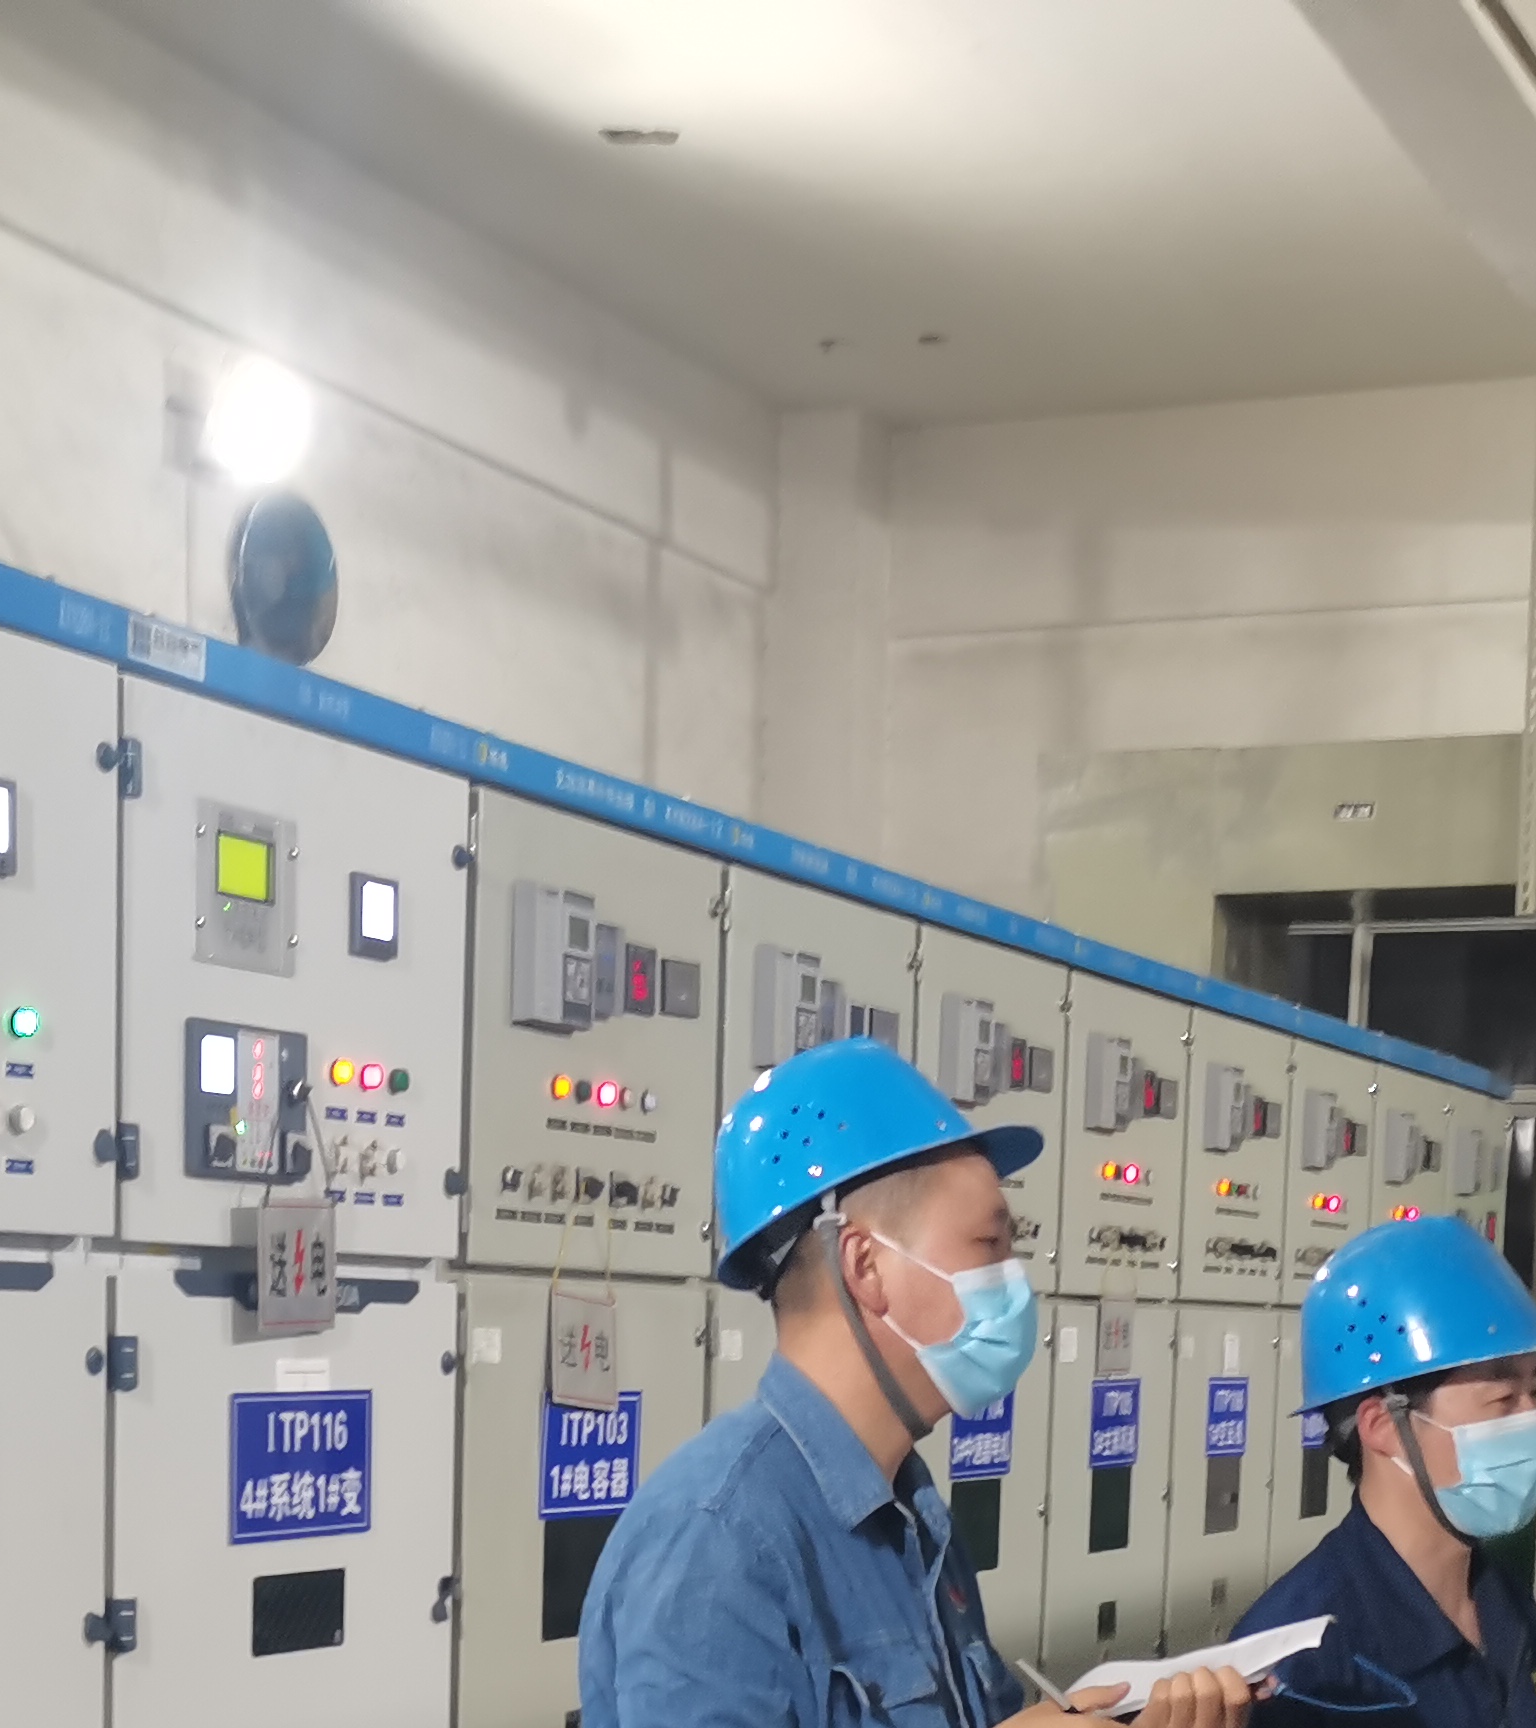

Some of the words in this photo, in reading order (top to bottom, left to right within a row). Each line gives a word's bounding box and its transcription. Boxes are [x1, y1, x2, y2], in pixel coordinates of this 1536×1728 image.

[559, 1325, 610, 1372] 送电
[267, 1410, 348, 1453] ITP116
[559, 1410, 629, 1447] ITP103
[549, 1457, 629, 1501] 1#电容器
